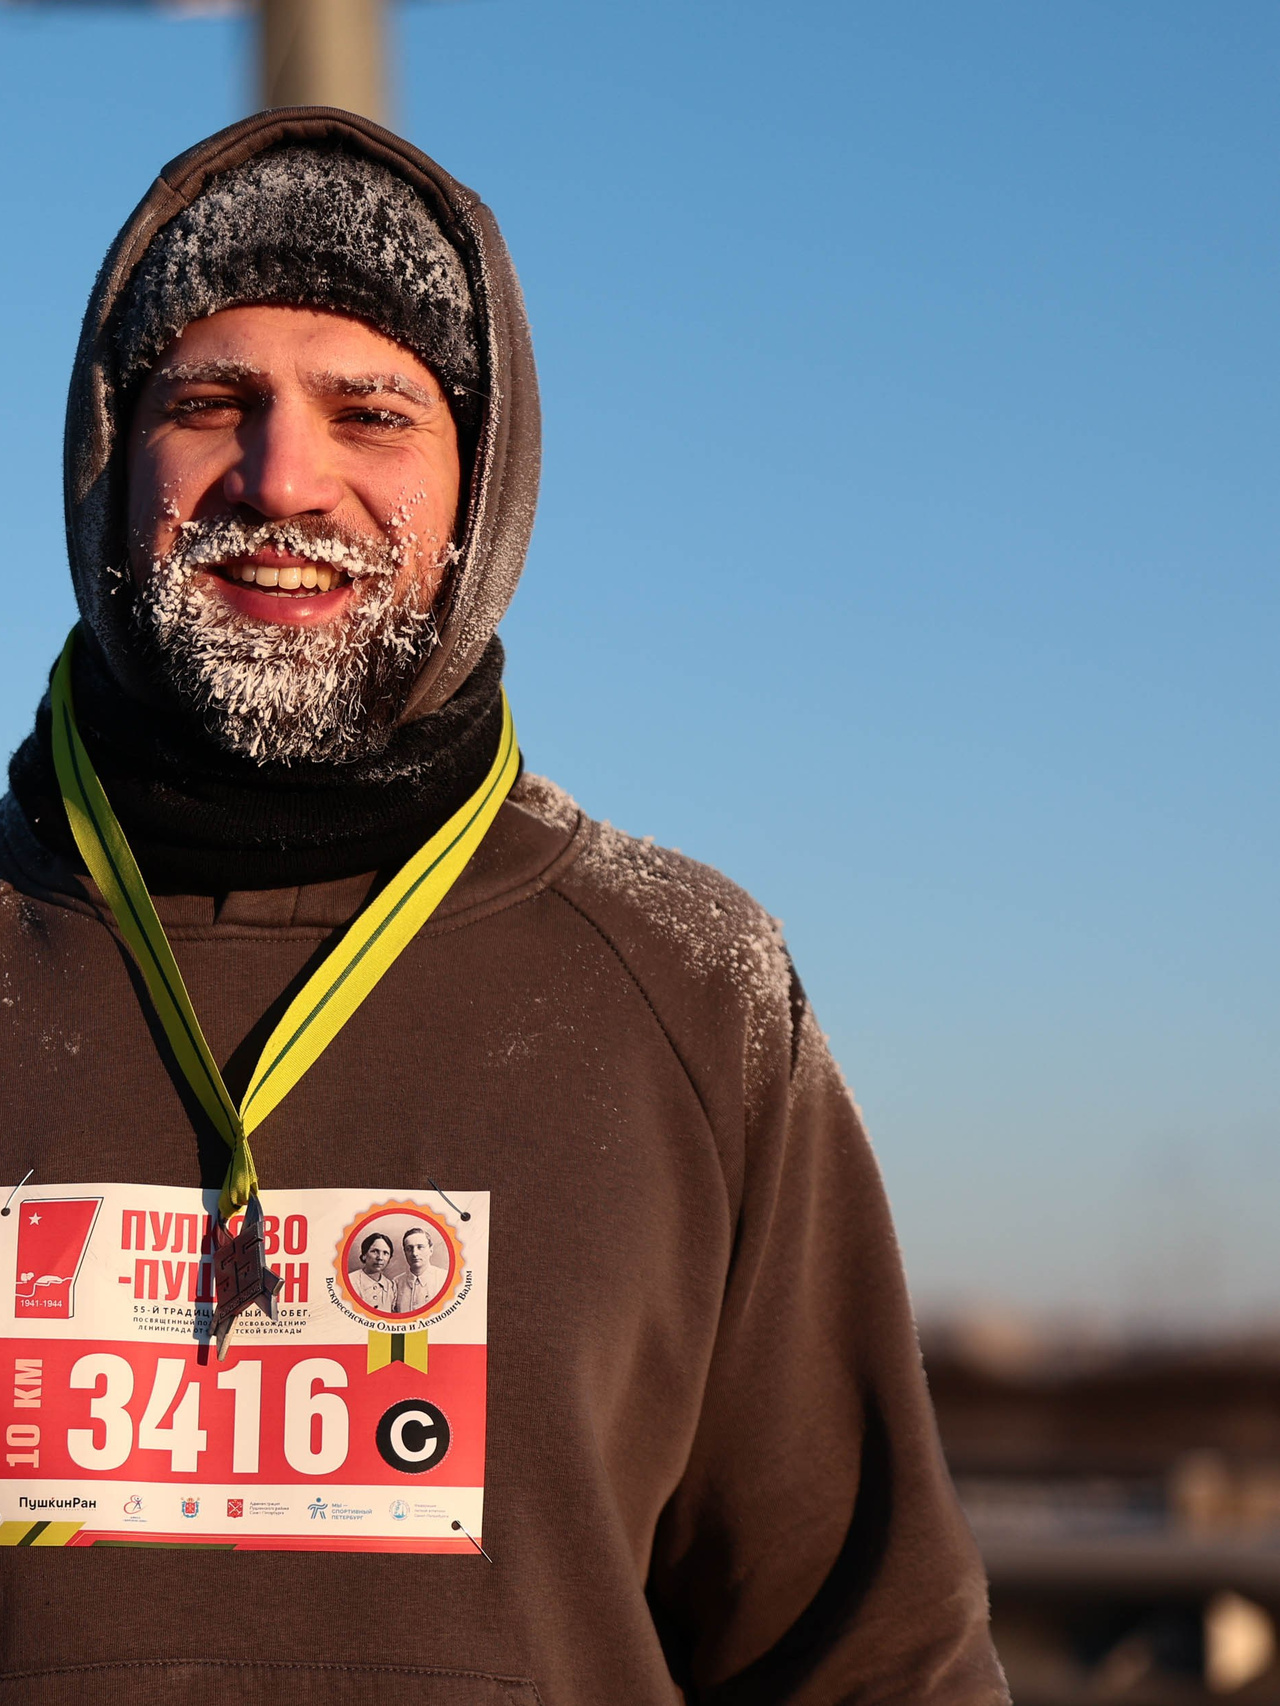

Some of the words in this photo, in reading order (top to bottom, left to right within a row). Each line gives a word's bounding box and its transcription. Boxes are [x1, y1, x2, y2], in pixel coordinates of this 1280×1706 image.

[119, 1259, 309, 1303] -ПУШН
[20, 1299, 62, 1308] 1941-1944
[133, 1305, 160, 1315] 55-Й
[163, 1307, 261, 1318] ТРАДИЦЫЙ
[325, 1276, 375, 1329] Воскресенская
[377, 1321, 407, 1332] Ольга
[418, 1300, 461, 1329] Лехнович
[458, 1270, 473, 1302] Вадим
[133, 1316, 195, 1326] ПОСВЯЩЕННЫЙ
[239, 1320, 307, 1328] ОСВОБОЖДЕНИЮ
[138, 1324, 192, 1334] ЛЕНИНГРАДА
[67, 1353, 349, 1475] 3416
[6, 1424, 40, 1469] 10
